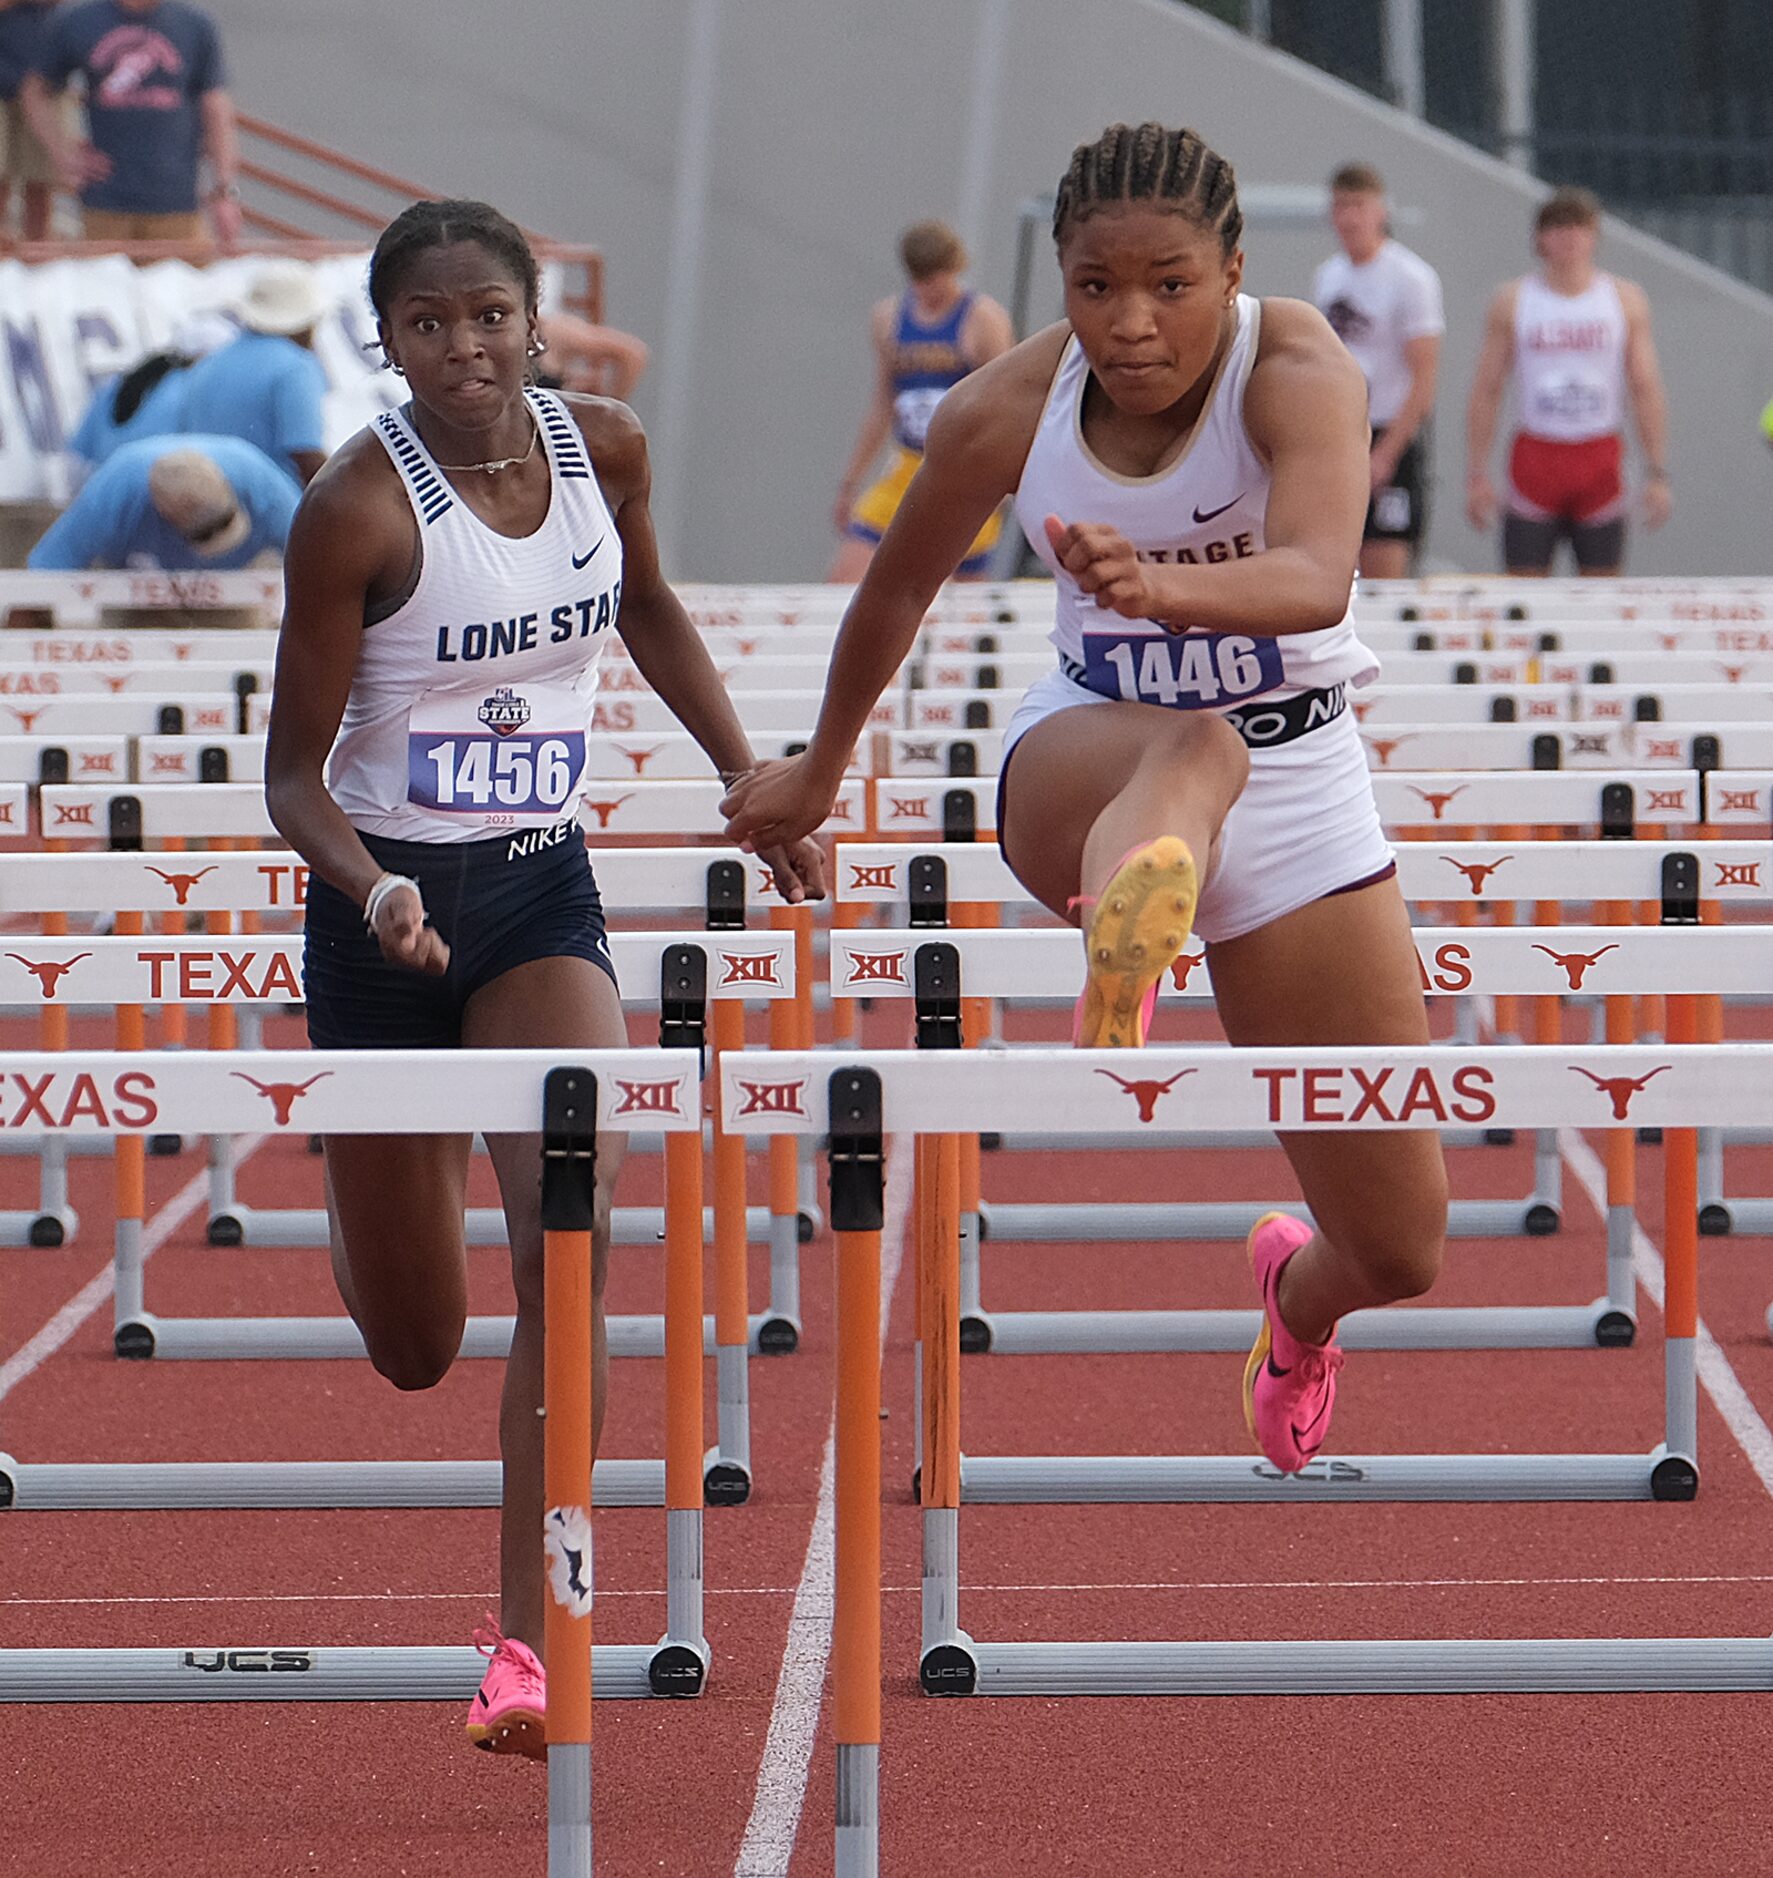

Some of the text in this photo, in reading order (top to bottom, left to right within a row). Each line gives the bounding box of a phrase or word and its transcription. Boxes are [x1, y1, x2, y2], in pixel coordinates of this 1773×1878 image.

[437, 613, 538, 662] LONE
[33, 640, 131, 662] TEXAS
[1105, 635, 1263, 705] 1446
[479, 707, 529, 719] STATE
[428, 740, 570, 805] 1456
[890, 798, 929, 818] XII
[1648, 789, 1686, 811] XII
[1719, 789, 1760, 811] XII
[54, 803, 94, 825] XII
[484, 815, 515, 825] 2023
[508, 825, 568, 861] NIKE
[850, 864, 897, 890] XII
[1714, 862, 1761, 887] XII
[722, 953, 778, 984] XII
[849, 952, 905, 982] XII
[0, 1071, 158, 1128] XAS
[614, 1079, 681, 1114] XII
[738, 1080, 805, 1116] XII
[1252, 1065, 1497, 1122] TEXAS
[184, 1651, 311, 1672] UCS
[926, 1667, 970, 1679] UCS
